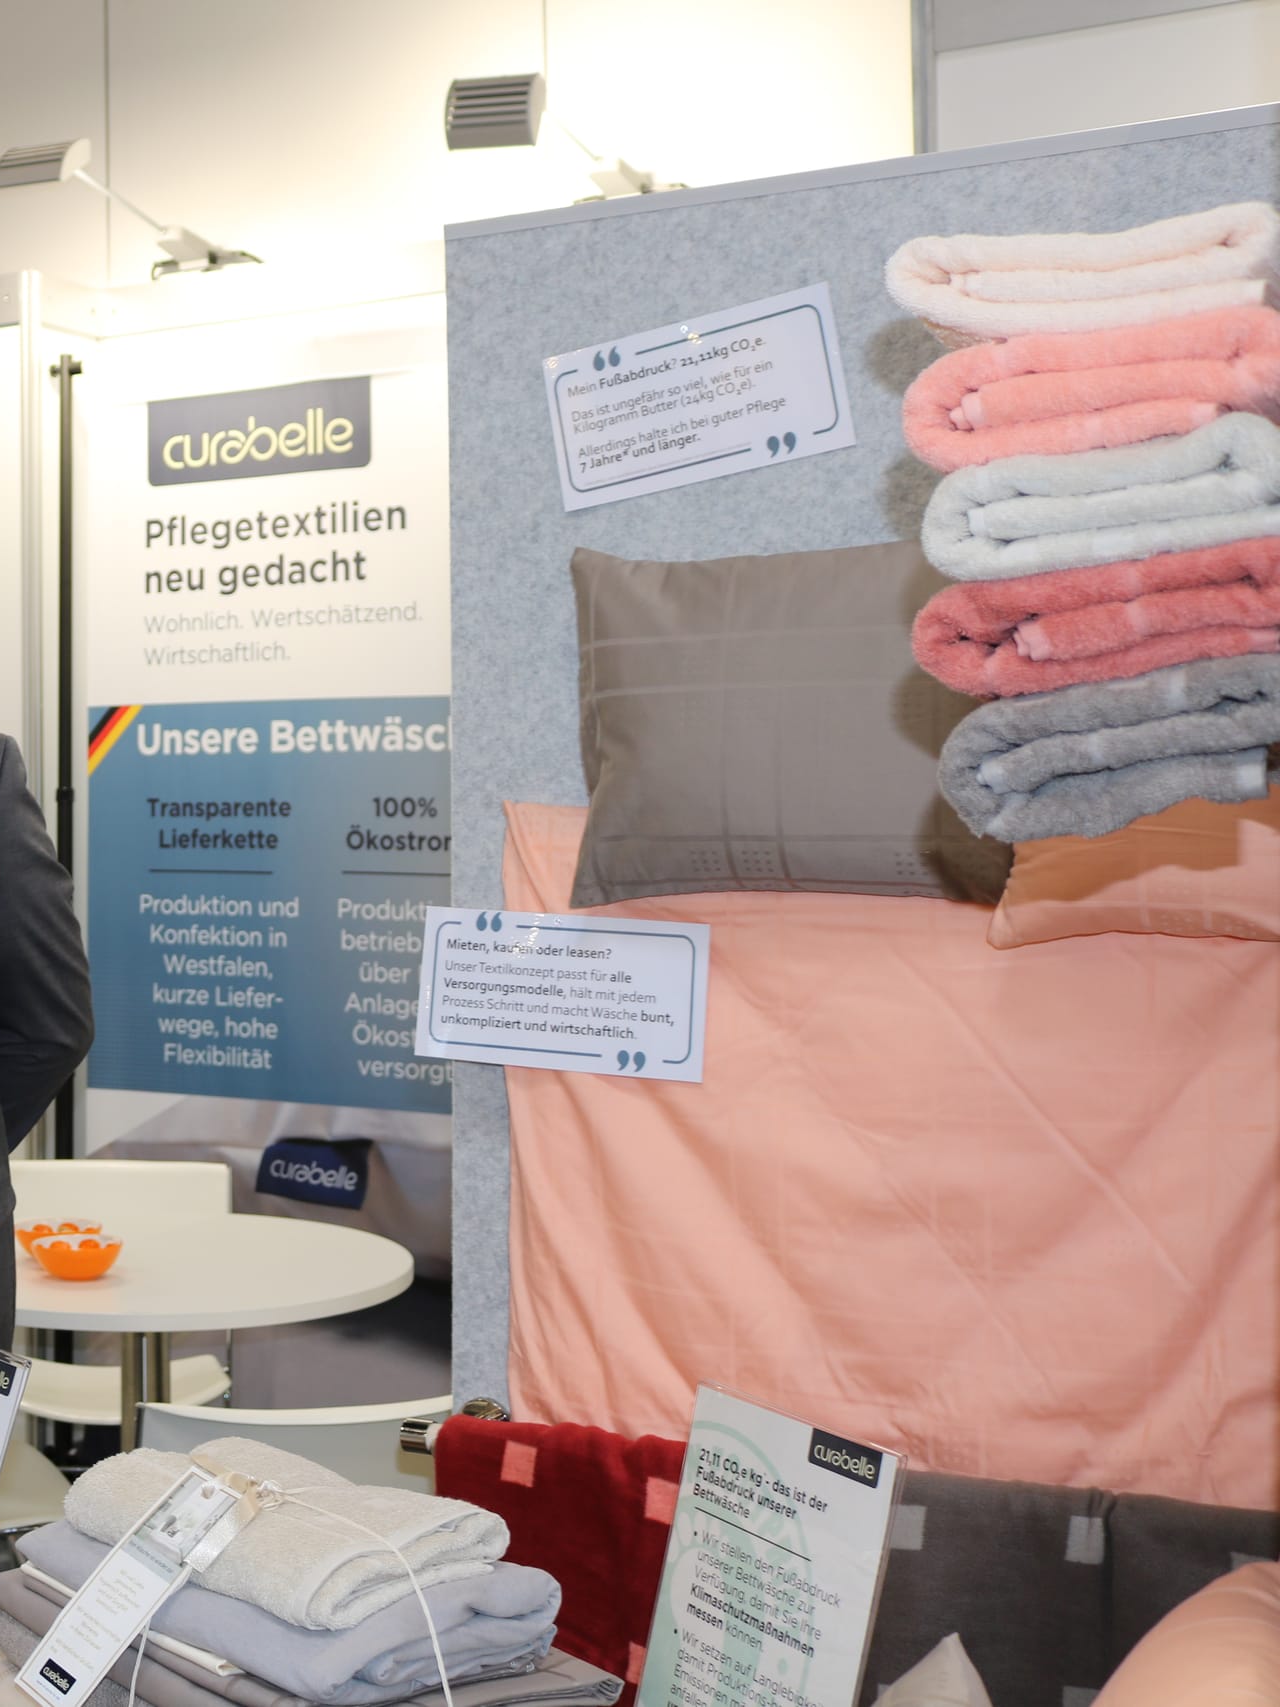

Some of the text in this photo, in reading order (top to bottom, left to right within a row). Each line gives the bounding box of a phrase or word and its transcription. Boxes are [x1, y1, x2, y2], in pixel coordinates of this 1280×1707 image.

[567, 380, 596, 398] Mein
[598, 357, 678, 389] Fußabdruck?
[679, 344, 728, 369] 21,11kg
[570, 358, 773, 423] Das ist ungefähr so viel, wie für ein
[572, 407, 638, 435] Kilogramm
[640, 397, 678, 417] Butter
[679, 387, 714, 408] (24kg
[163, 407, 354, 470] curabelle
[577, 394, 787, 460] Allerdings halte ich bei guter Pflege
[579, 461, 587, 473] 7
[631, 442, 655, 458] und
[657, 430, 701, 453] länger.
[145, 501, 407, 549] Pflegetextilien
[145, 551, 367, 595] neu gedacht
[144, 602, 423, 633] Wohnlich. Wertschätzend.
[144, 641, 291, 666] Wirtschaftlich.
[137, 723, 258, 756] Unsere
[147, 798, 292, 820] Transparente
[373, 797, 437, 817] 100%
[159, 829, 278, 849] Lieferkette
[139, 893, 299, 917] Produktion und
[337, 898, 432, 921] Produkt
[150, 924, 287, 947] Konfektion in
[340, 929, 422, 951] betrieb
[446, 938, 489, 954] Mieten,
[535, 944, 563, 956] oder
[565, 946, 611, 960] leasen?
[163, 954, 272, 980] Westfalen,
[359, 962, 411, 984] über
[444, 960, 632, 984] Unser Textilkonzept passt für alle
[153, 983, 283, 1009] kurze Liefer-
[344, 992, 419, 1019] Anlage
[443, 977, 656, 1006] Versorgungsmodelle, hält mit jedem
[440, 1012, 637, 1040] unkompliziert und wirtschaftlich.
[441, 995, 674, 1026] Prozess Schritt und macht Wäsche bunt,
[158, 1016, 278, 1039] wege, hohe
[352, 1020, 416, 1048] Ökos
[164, 1043, 272, 1069] Flexibilität
[270, 1159, 358, 1190] curabelle
[813, 1443, 876, 1480] curabelle
[695, 1465, 797, 1520] Fußabdruck unserer
[698, 1447, 721, 1469] 21,11
[771, 1478, 791, 1497] das
[792, 1486, 807, 1504] ist
[808, 1493, 828, 1513] der
[692, 1482, 750, 1519] Bettwäsche
[696, 1549, 815, 1617] unserer Bettwäsche zur
[701, 1530, 841, 1609] Wir stellen den Fußabdruck
[692, 1565, 822, 1641] Verfügung, damit Sie Ihre
[686, 1602, 765, 1653] messen können.
[689, 1582, 815, 1658] Klimaschutzmaßnahmen
[677, 1647, 705, 1672] damit
[681, 1628, 751, 1677] Wir setzen auf
[673, 1663, 728, 1705] Emissionen
